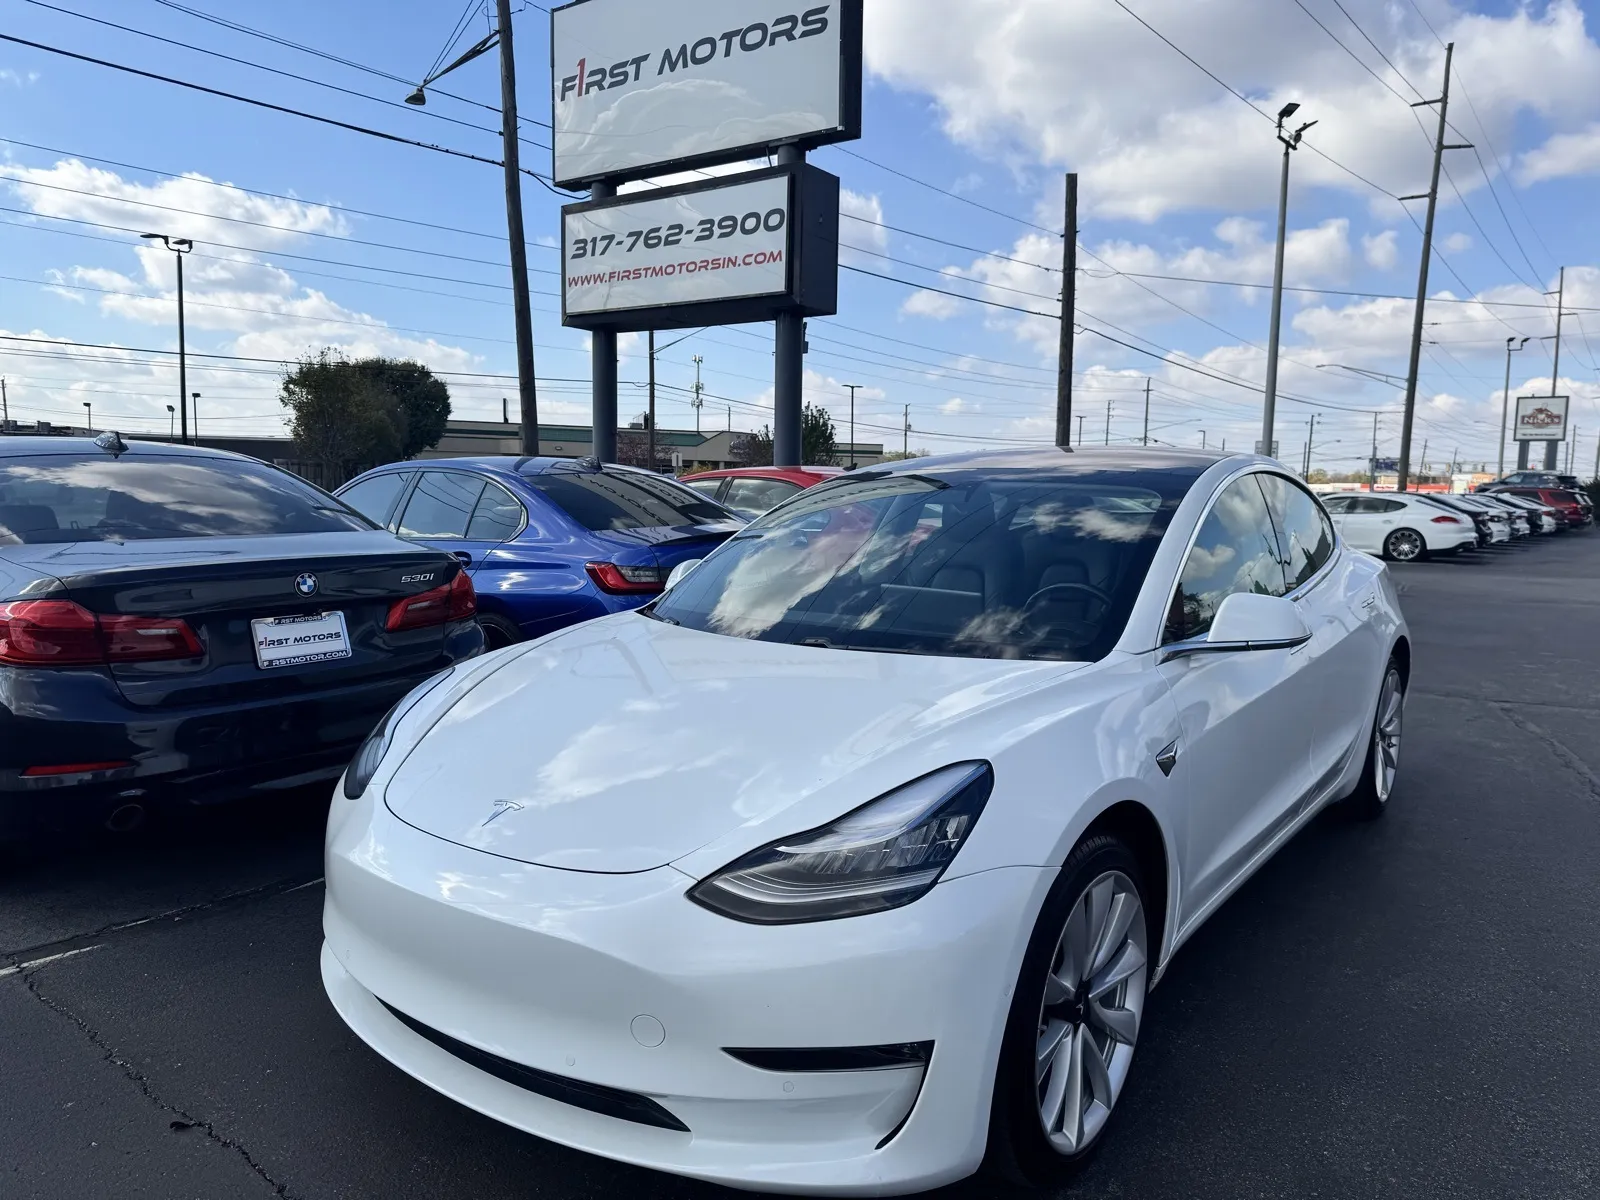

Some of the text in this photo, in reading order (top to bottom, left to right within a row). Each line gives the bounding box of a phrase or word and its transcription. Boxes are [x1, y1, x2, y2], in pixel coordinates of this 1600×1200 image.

[657, 4, 830, 76] MOTORS
[570, 207, 786, 260] 317-762-3900
[567, 249, 783, 288] WWW.FIRSTMOTORSIN.COM
[293, 631, 342, 644] MOTORS
[294, 615, 322, 623] MOTORS
